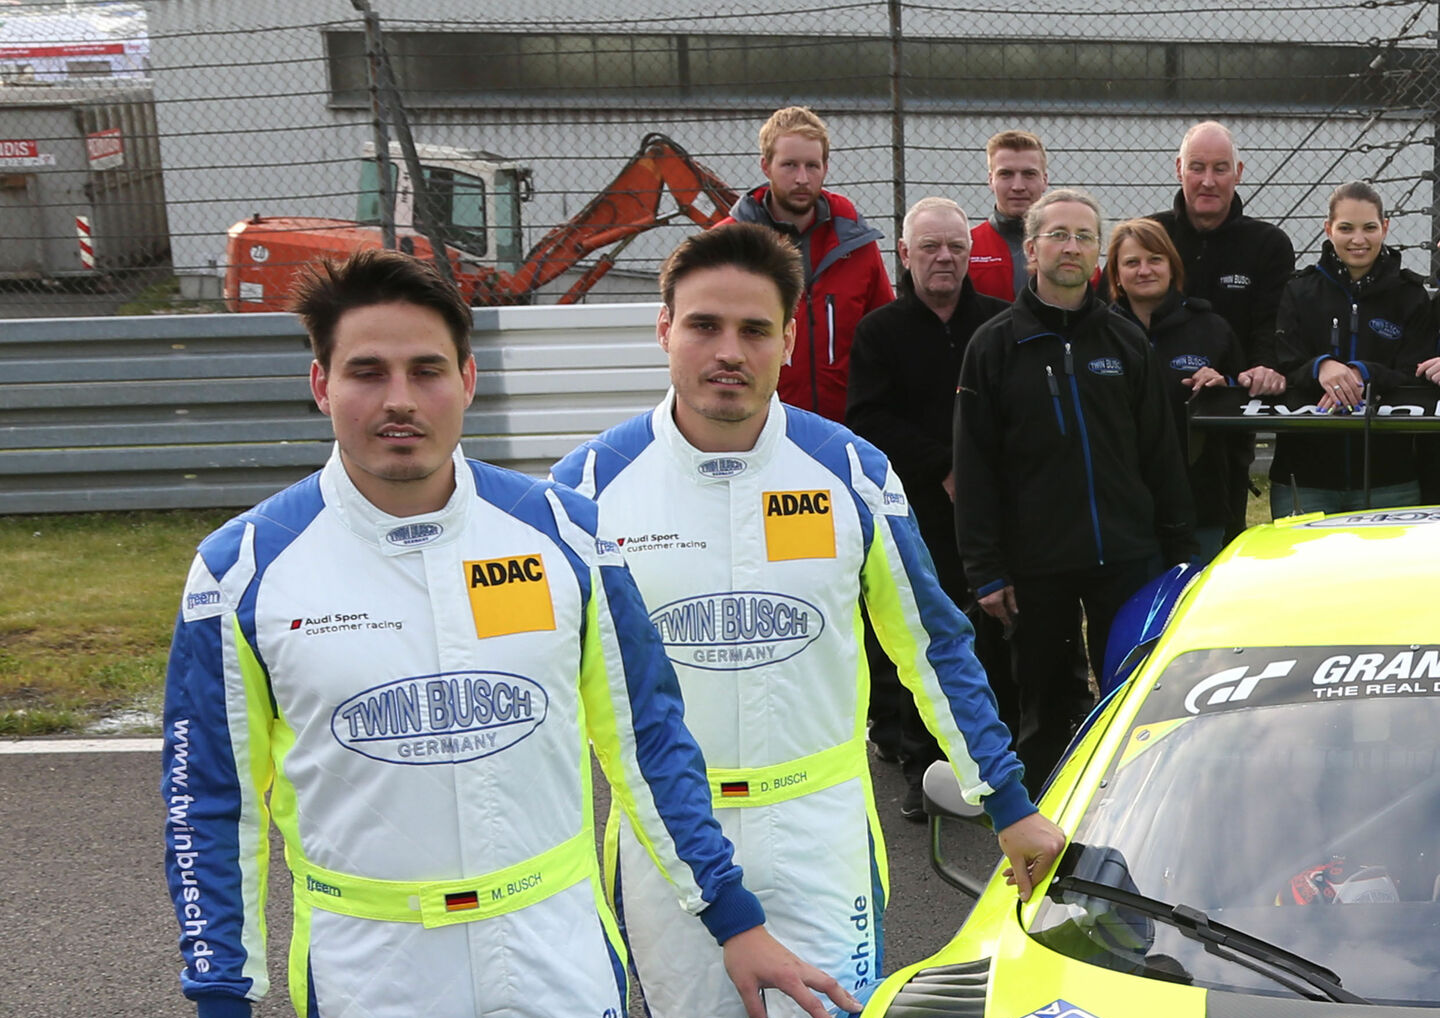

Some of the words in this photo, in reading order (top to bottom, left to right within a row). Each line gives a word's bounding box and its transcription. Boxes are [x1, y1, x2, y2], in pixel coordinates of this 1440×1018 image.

[767, 492, 830, 517] ADAC
[627, 535, 649, 545] Audi
[651, 533, 680, 544] Sport
[627, 542, 674, 553] customer
[676, 540, 707, 550] racing
[471, 557, 543, 589] ADAC
[305, 615, 332, 626] Audi
[335, 612, 370, 623] Sport
[306, 623, 363, 636] customer
[366, 621, 403, 631] racing
[652, 599, 716, 642] TWIN
[722, 596, 808, 641] BUSCH
[693, 645, 776, 663] GERMANY
[1313, 686, 1363, 699] THE
[1366, 683, 1427, 697] REAL
[342, 684, 422, 738] TWIN
[424, 677, 533, 731] BUSCH
[398, 732, 498, 759] GERMANY
[760, 780, 772, 793] D.
[773, 771, 808, 791] BUSCH
[166, 717, 214, 975] www.twinbusch.de
[491, 887, 505, 902] M.
[507, 872, 543, 897] BUSCH
